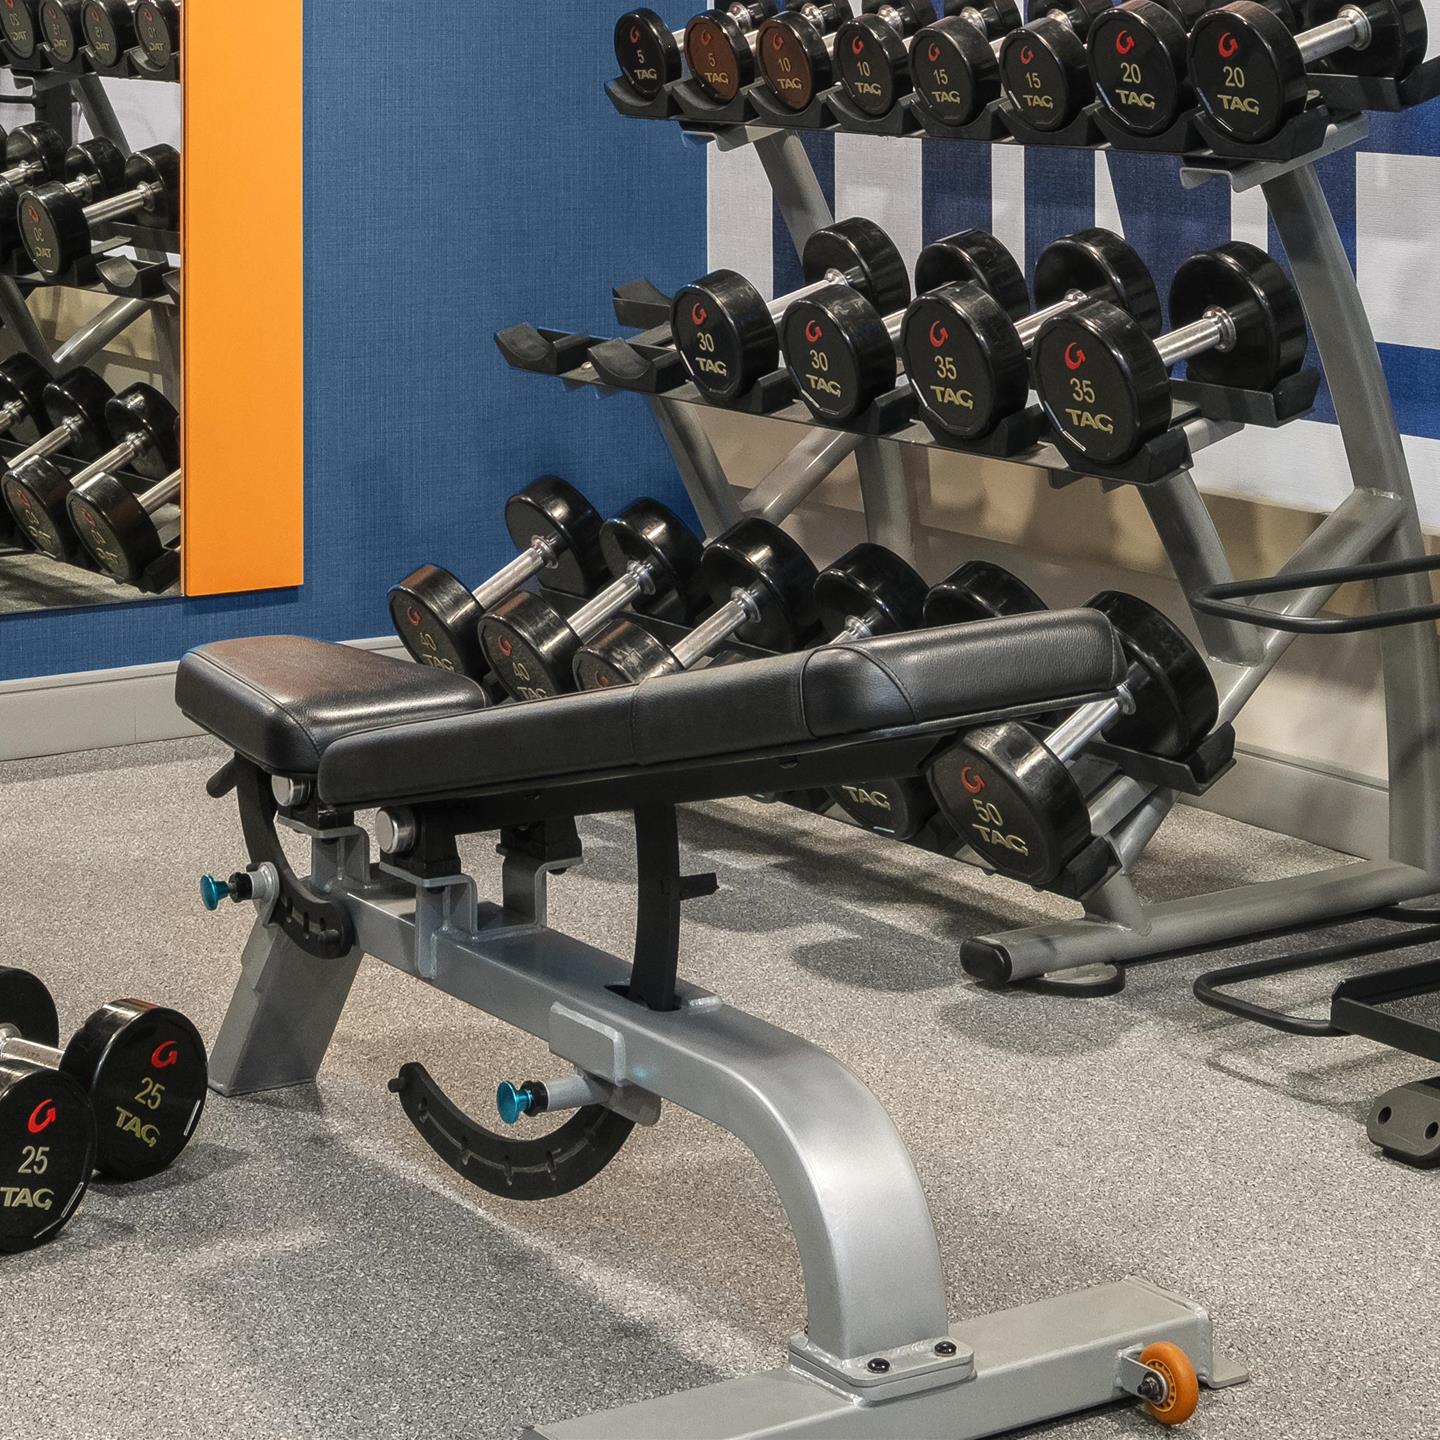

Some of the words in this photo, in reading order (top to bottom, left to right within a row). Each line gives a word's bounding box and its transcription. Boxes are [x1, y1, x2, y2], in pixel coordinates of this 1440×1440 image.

[637, 49, 645, 64] 5
[709, 53, 716, 67] 5
[778, 58, 791, 73] 10
[633, 68, 657, 81] TAG
[704, 72, 729, 85] TAG
[857, 61, 871, 77] 10
[932, 68, 949, 85] 15
[1120, 62, 1142, 84] 20
[1223, 66, 1245, 88] 20
[776, 78, 802, 91] TAG
[855, 82, 882, 96] TAG
[1025, 72, 1041, 89] 15
[931, 90, 961, 105] TAG
[1023, 94, 1054, 110] TAG
[1115, 89, 1156, 110] TAG
[1217, 94, 1260, 115] TAG
[697, 332, 715, 353] 30
[695, 357, 727, 377] TAG
[810, 349, 828, 372] 30
[934, 355, 957, 380] 35
[805, 374, 842, 398] TAG
[1070, 377, 1096, 403] 35
[930, 385, 974, 410] TAG
[1065, 408, 1114, 434] TAG
[419, 632, 438, 652] 40
[512, 661, 531, 681] 40
[841, 785, 891, 811] TAG
[972, 798, 1004, 827] 50
[972, 823, 1029, 857] TAG
[134, 1076, 166, 1110] 25
[113, 1106, 161, 1148] TAG
[17, 1145, 50, 1176] 25
[0, 1186, 56, 1211] TAG
